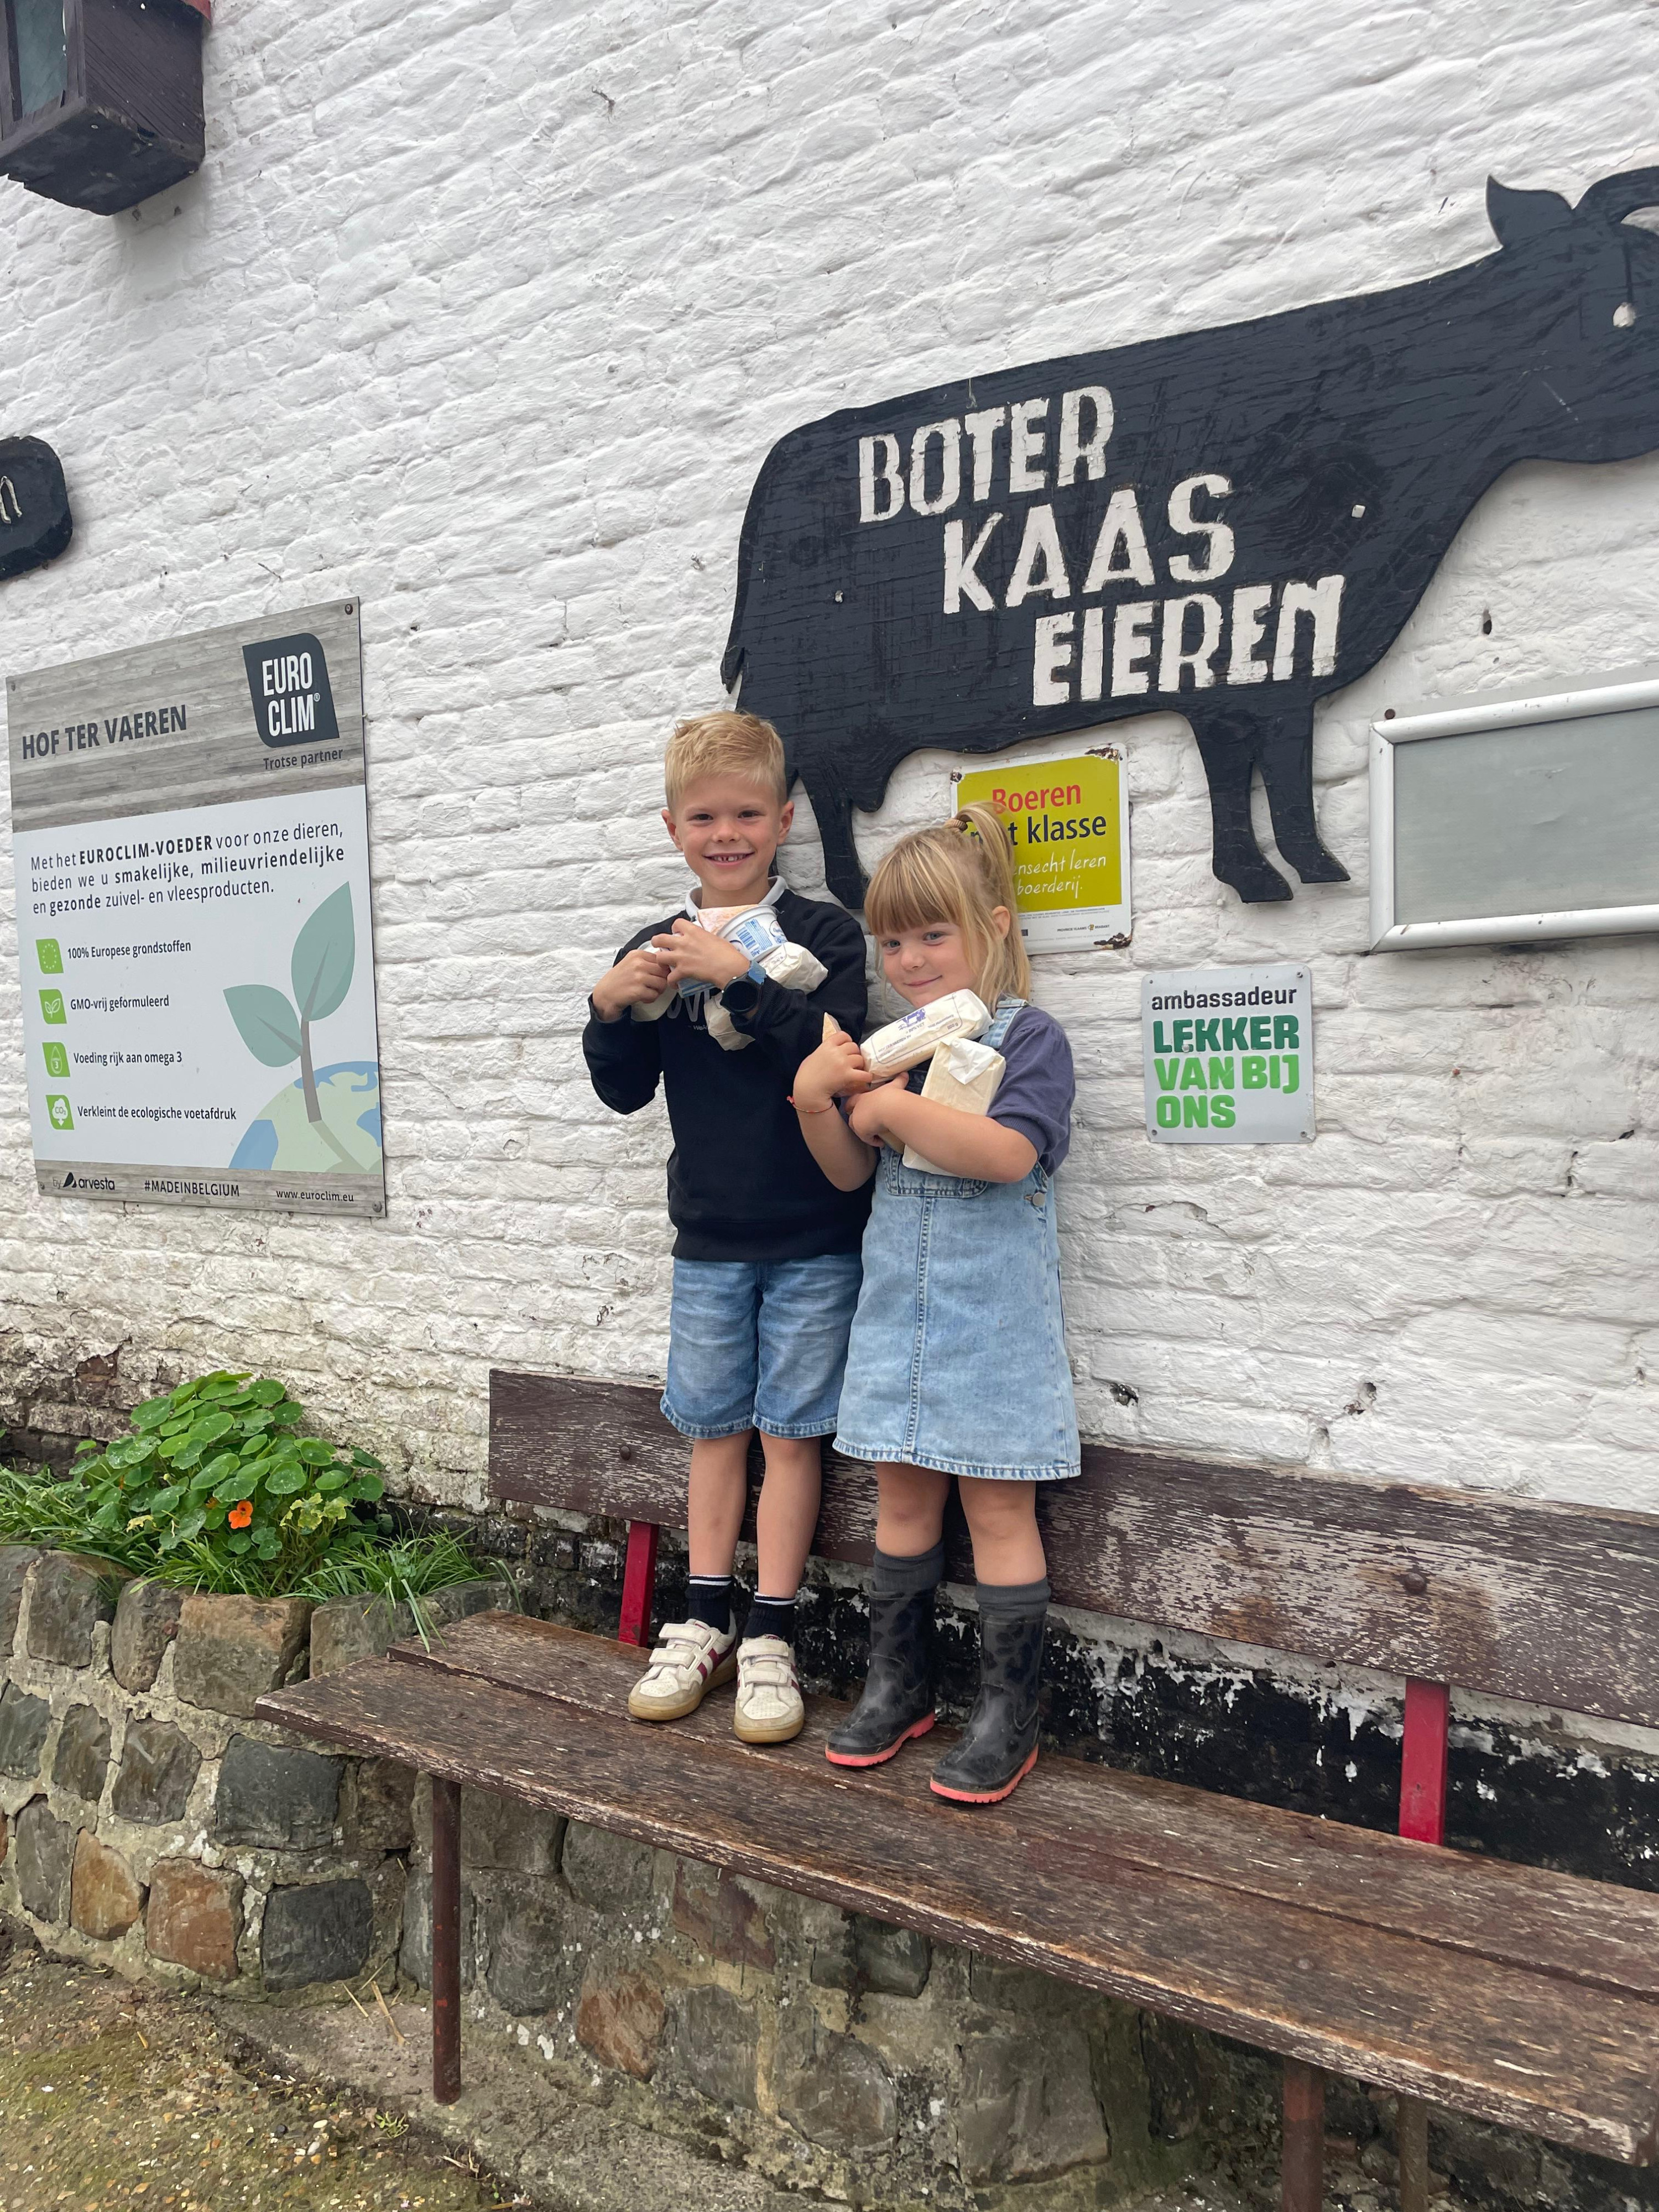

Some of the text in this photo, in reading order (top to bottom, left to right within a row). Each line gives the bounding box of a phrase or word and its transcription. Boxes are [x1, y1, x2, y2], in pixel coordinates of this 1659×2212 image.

[859, 385, 1115, 523] BOTER
[943, 473, 1235, 614] KAAS
[1032, 574, 1346, 706] EIEREN
[262, 652, 313, 696] EURO
[23, 705, 187, 759] HOF TER VAEREN
[263, 749, 343, 770] Trotse partner
[992, 784, 1081, 814] Boeren
[1027, 814, 1107, 844] klasse
[31, 823, 343, 870] Met het EUROCLIM-VOEDER voor onze dieren,
[1070, 848, 1107, 870] leren
[32, 845, 345, 892] bieden we u smakelijke, milieuvriendelijke
[33, 880, 274, 917] en gezonde zuivel- en vleesproducten.
[1017, 874, 1083, 899] boerderij.
[67, 940, 191, 959] 100% Europese grondstoffen
[70, 994, 169, 1012] GMO-vrij geformuleerd
[1151, 986, 1297, 1010] ambassadeur
[1153, 1015, 1300, 1053] LEKKER
[74, 1051, 182, 1066] Voeding rijk aan omega 3
[1154, 1054, 1300, 1094] VAN BIJ
[77, 1105, 237, 1121] Verkleint de ecologische voetafdruk
[1156, 1094, 1236, 1129] ONS
[79, 1177, 116, 1191] arvesta
[144, 1179, 239, 1197] #MADEINBELGIUM
[276, 1190, 354, 1202] www.euroclim.eu
